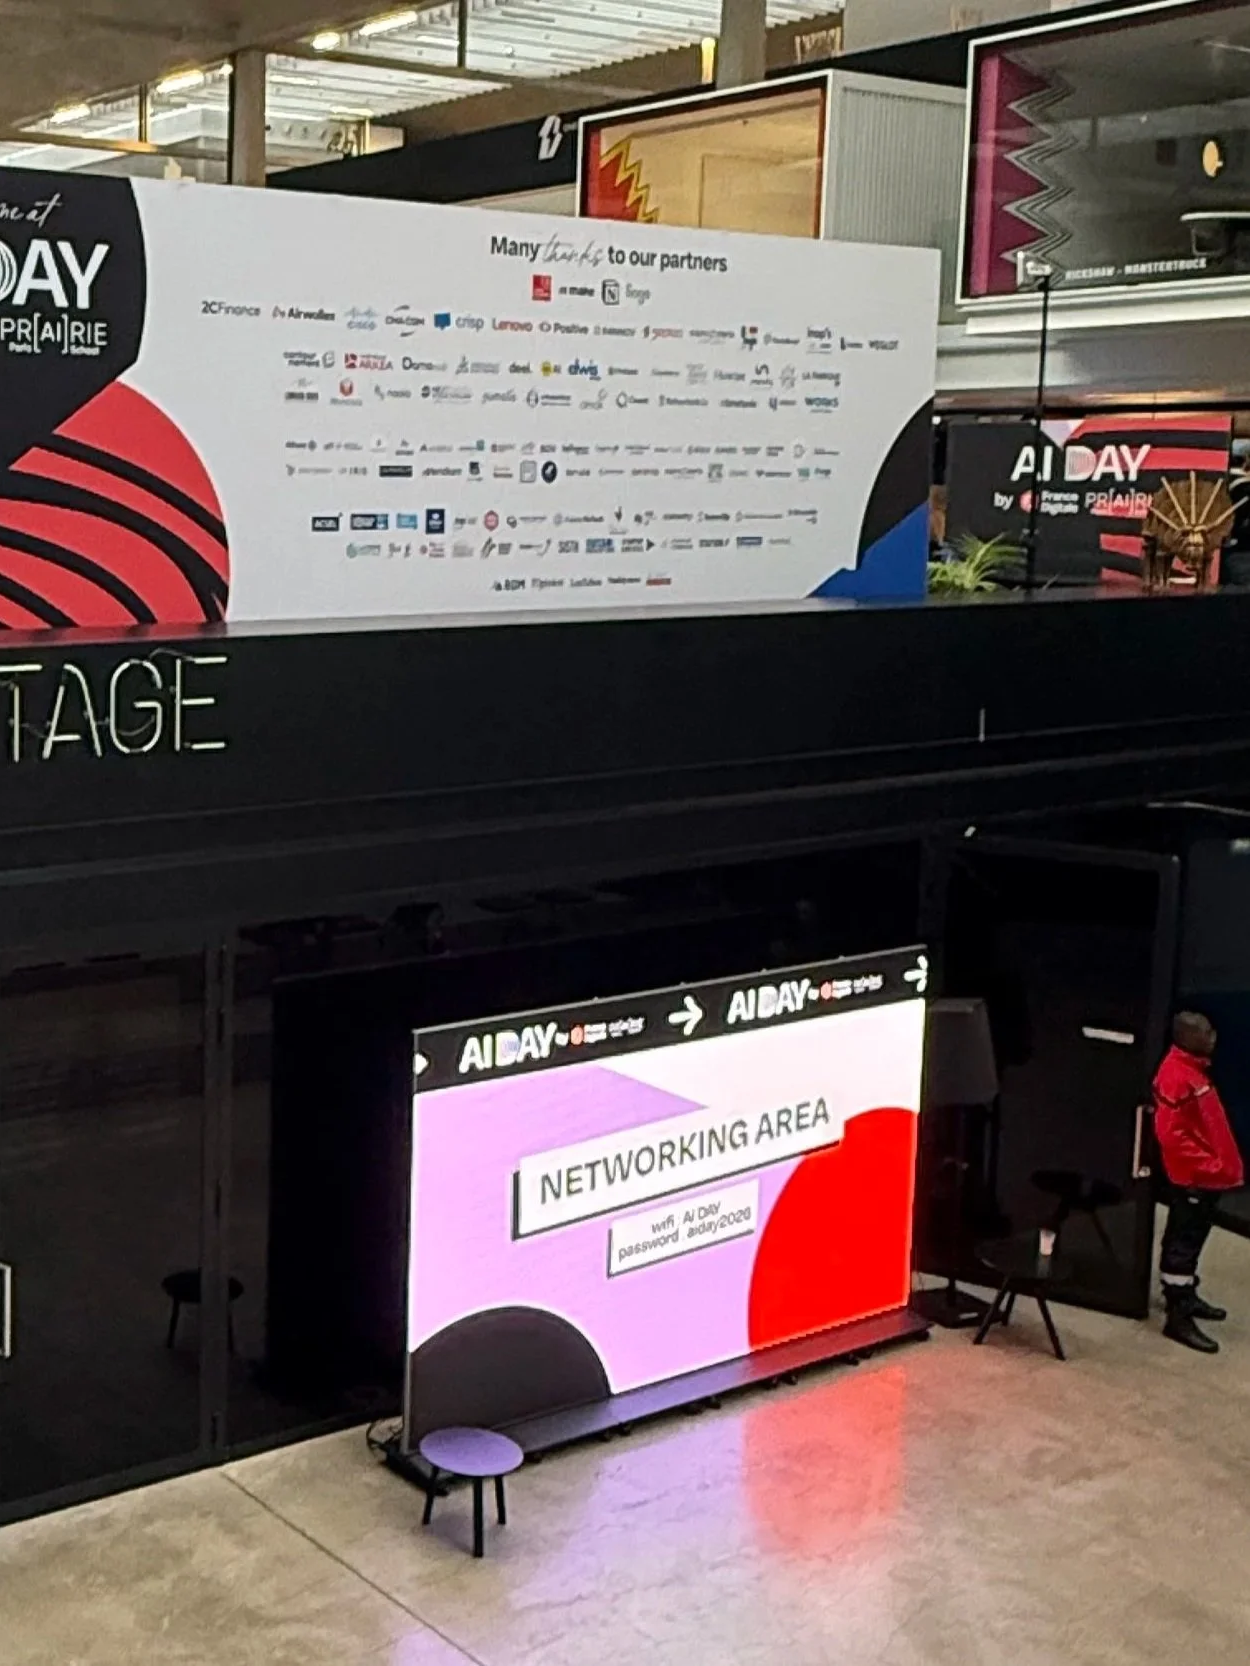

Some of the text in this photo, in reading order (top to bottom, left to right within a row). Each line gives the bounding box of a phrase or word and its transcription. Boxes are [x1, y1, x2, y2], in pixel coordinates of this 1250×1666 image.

[24, 192, 64, 228] at
[491, 232, 728, 273] Many thanks to our partners
[455, 314, 485, 333] crisp
[492, 317, 533, 332] Lenovo
[1010, 444, 1152, 482] AI DAY
[993, 491, 1014, 511] by
[1041, 490, 1079, 502] France
[726, 988, 756, 1025] AI
[757, 978, 812, 1019] DAY
[458, 1033, 494, 1075] AI
[495, 1022, 558, 1067] DAY
[540, 1096, 831, 1206] NETWORKING AREA
[651, 1214, 675, 1235] wifi
[698, 1201, 722, 1221] DAY
[618, 1225, 680, 1264] password
